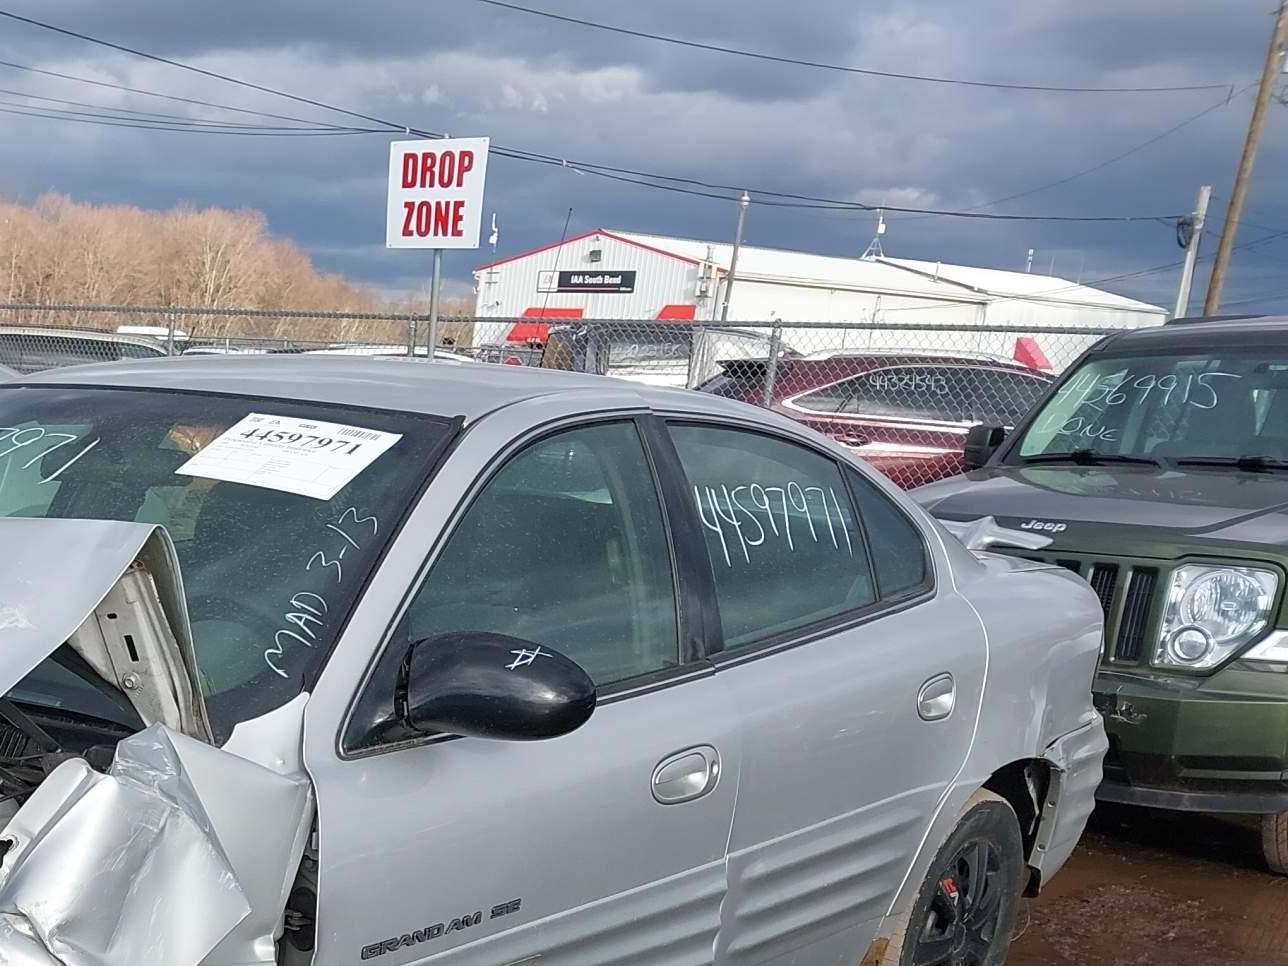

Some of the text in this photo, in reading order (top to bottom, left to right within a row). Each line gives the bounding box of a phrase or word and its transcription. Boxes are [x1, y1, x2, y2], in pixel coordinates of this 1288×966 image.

[401, 150, 474, 189] DROP
[401, 199, 466, 238] ZONE
[570, 274, 583, 285] IAA
[584, 275, 603, 285] South
[240, 427, 363, 456] 44597971
[694, 481, 854, 568] 44597971
[1020, 519, 1067, 533] Jeep
[360, 922, 445, 960] GRAND
[444, 911, 482, 936] AM
